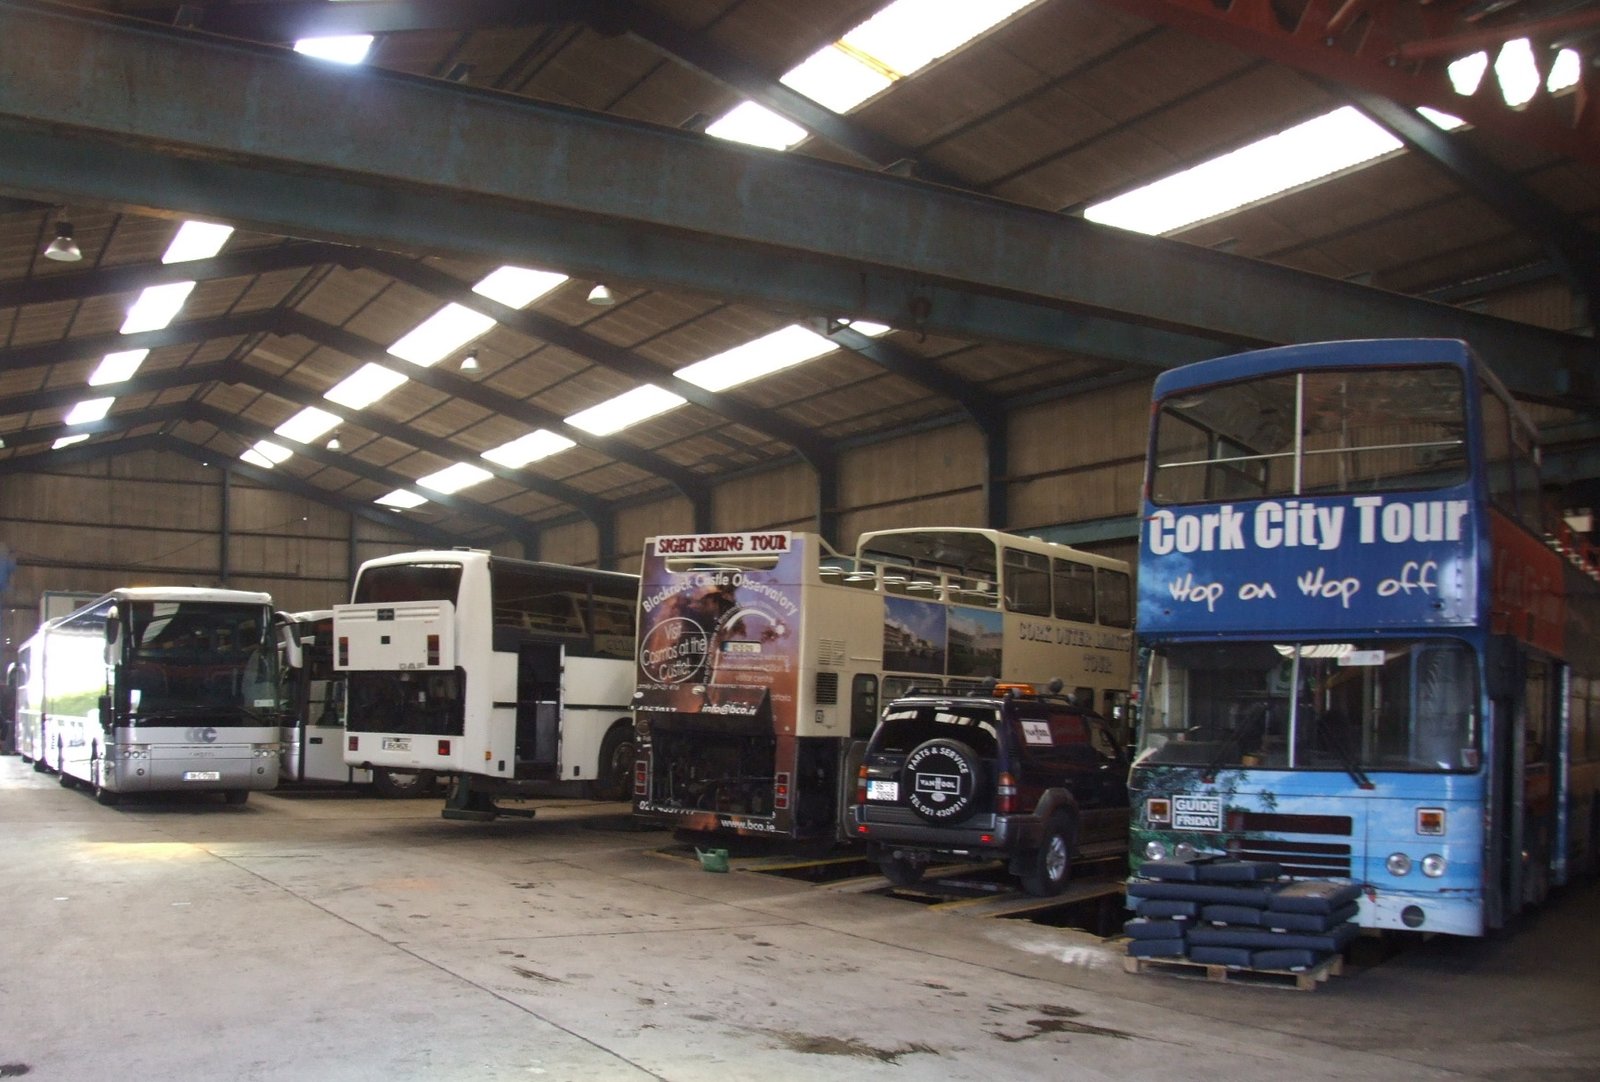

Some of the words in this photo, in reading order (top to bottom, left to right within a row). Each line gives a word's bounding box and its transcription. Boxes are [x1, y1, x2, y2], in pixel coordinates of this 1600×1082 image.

[1149, 505, 1245, 555] Cork
[1254, 500, 1345, 550] City
[1353, 496, 1468, 544] Tour
[658, 536, 696, 553] SIGHT
[698, 535, 744, 552] SEEING
[751, 534, 787, 550] TOUR
[642, 578, 693, 613] Blackrock
[695, 571, 730, 587] Castle
[732, 573, 799, 616] Observatory
[1168, 573, 1224, 613] Hop
[1238, 582, 1277, 600] on
[1297, 567, 1361, 609] Hop
[1377, 561, 1438, 597] off
[664, 622, 683, 640] Visit
[642, 645, 678, 666] Cosmos
[678, 640, 690, 659] at
[690, 636, 706, 654] the
[907, 748, 931, 771] PARTS
[939, 747, 969, 774] SERVICE
[909, 793, 920, 809] TEL
[920, 805, 934, 816] 021
[1176, 799, 1218, 812] GUIDE
[720, 818, 776, 832] www.bco.ie
[1176, 815, 1218, 827] FRIDAY
